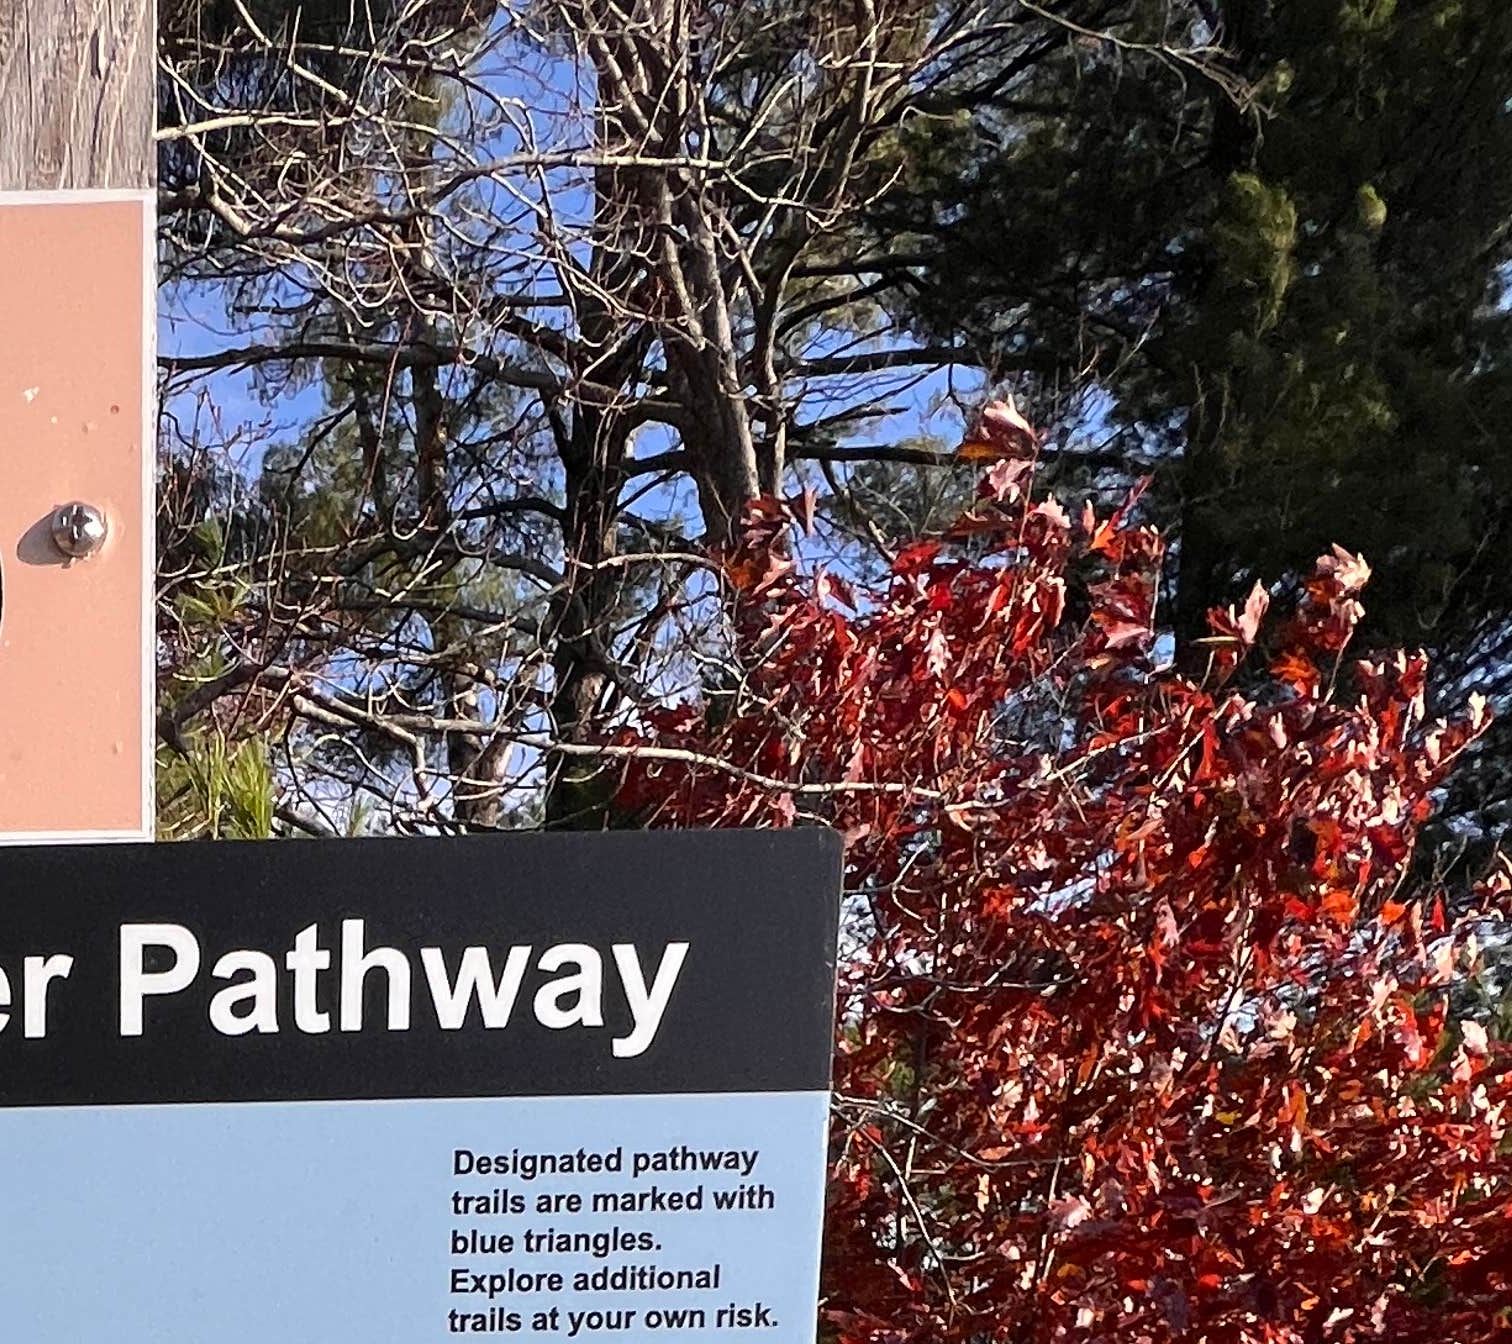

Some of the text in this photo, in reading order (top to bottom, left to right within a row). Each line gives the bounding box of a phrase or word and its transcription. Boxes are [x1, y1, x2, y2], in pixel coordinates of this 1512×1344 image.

[119, 919, 689, 1058] Pathway
[454, 1146, 759, 1180] Designated pathway
[452, 1185, 775, 1214] trails are marked with
[451, 1227, 662, 1257] blue triangles.
[450, 1264, 720, 1298] Explore additional
[448, 1303, 779, 1337] trails at your own risk.
